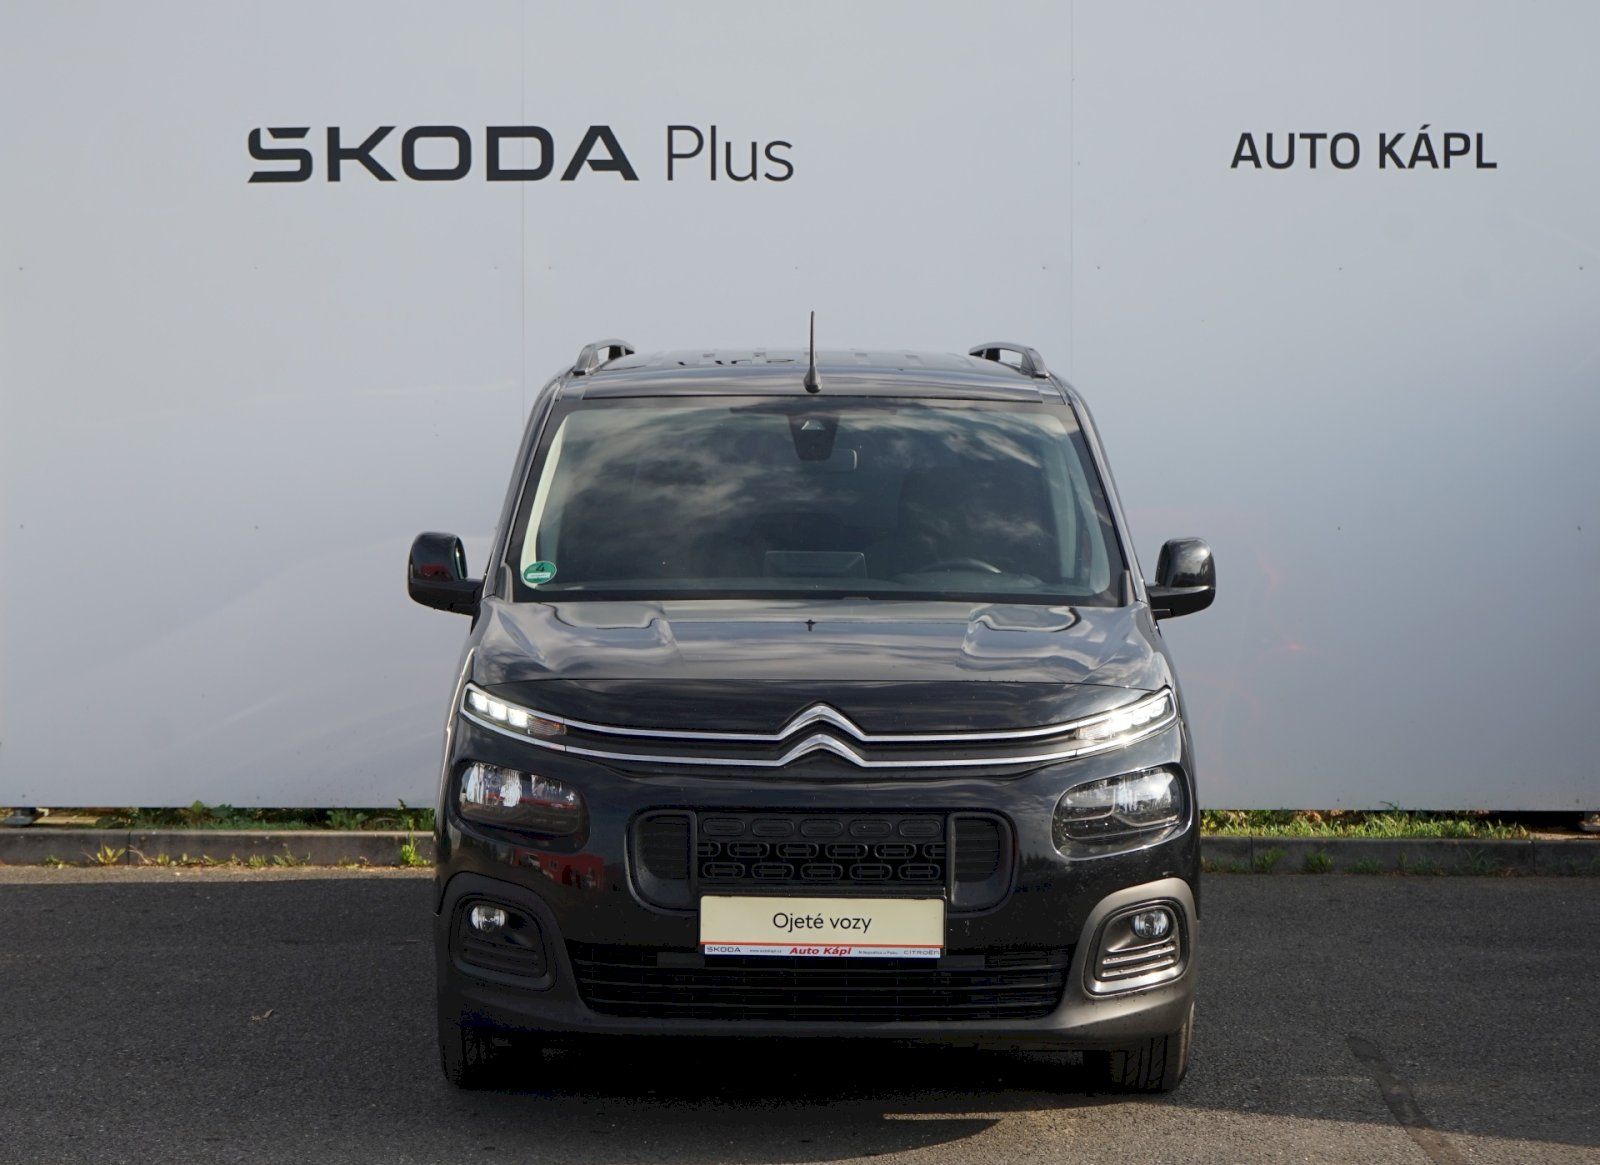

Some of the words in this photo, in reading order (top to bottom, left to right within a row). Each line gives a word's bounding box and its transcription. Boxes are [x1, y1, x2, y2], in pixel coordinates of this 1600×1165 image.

[666, 124, 795, 182] Plus
[1230, 132, 1361, 170] AUTO
[1378, 123, 1498, 170] KÁPL
[536, 561, 545, 572] 4
[772, 912, 824, 933] Ojeté
[829, 917, 872, 934] vozy
[789, 947, 820, 955] Auto
[823, 946, 852, 957] Kápl
